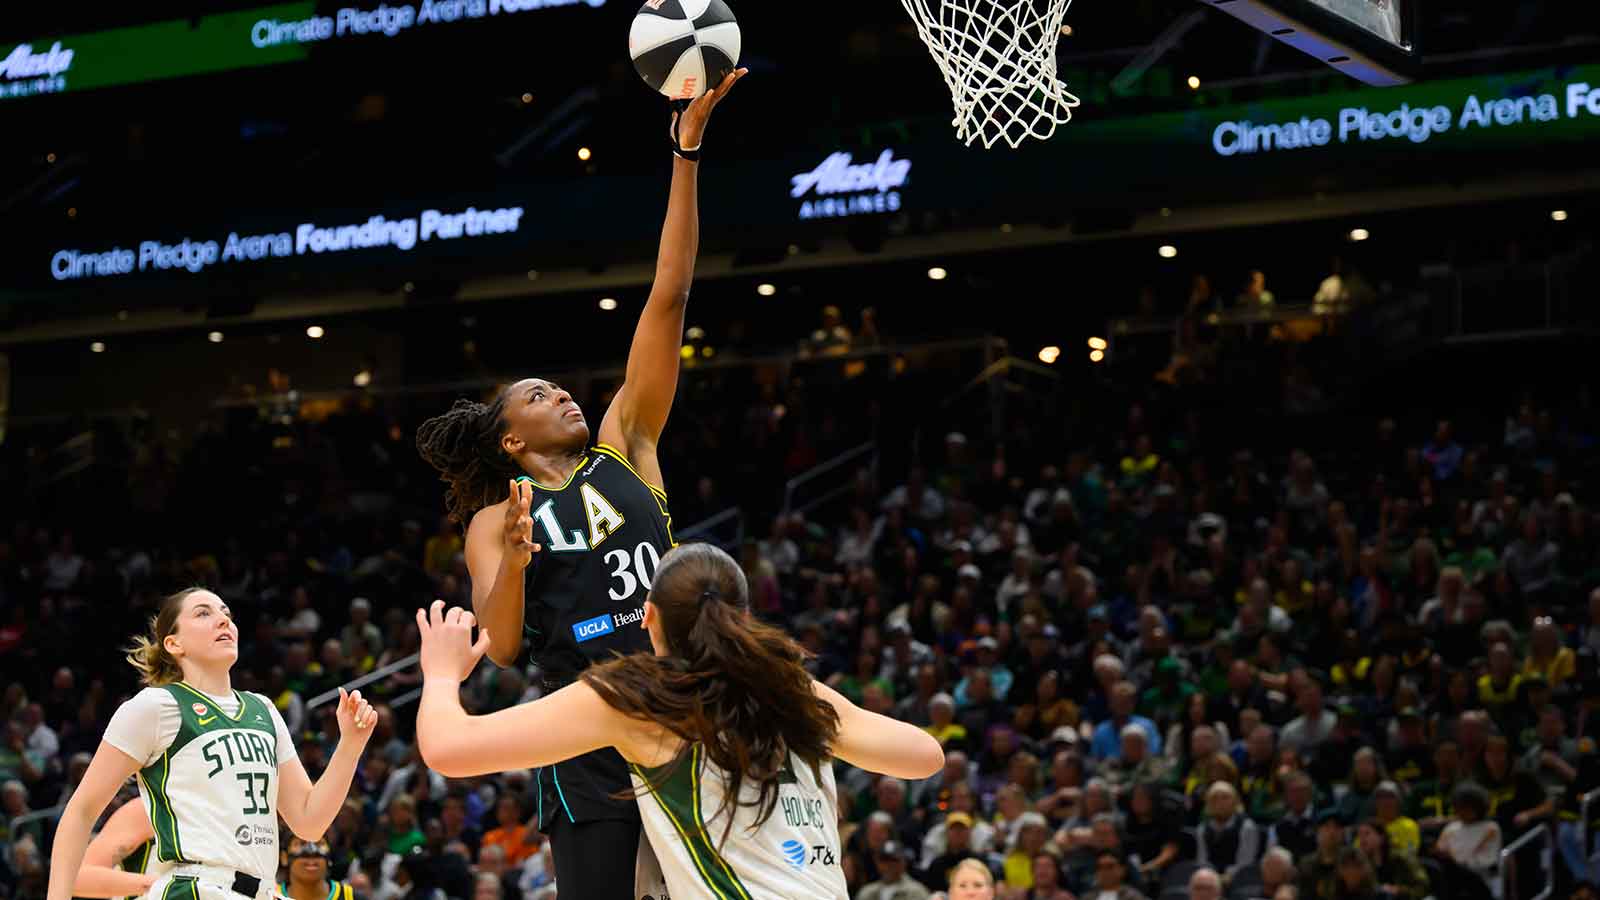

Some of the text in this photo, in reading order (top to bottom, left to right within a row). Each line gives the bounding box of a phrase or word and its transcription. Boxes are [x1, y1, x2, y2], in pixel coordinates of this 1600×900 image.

[251, 16, 332, 48] Climate
[336, 5, 415, 37] Pledge
[417, 0, 487, 25] Arena
[1213, 116, 1332, 156] Climate
[1338, 102, 1451, 143] Pledge
[1458, 93, 1557, 129] Arena
[790, 149, 911, 198] Alaska
[800, 192, 901, 219] AIRLINES
[51, 206, 524, 280] Climate Pledge Arena Founding Partner
[533, 481, 625, 551] LA
[603, 541, 661, 600] 30
[579, 620, 609, 637] UCLA
[236, 772, 270, 815] 33
[781, 796, 824, 829] HOLMES
